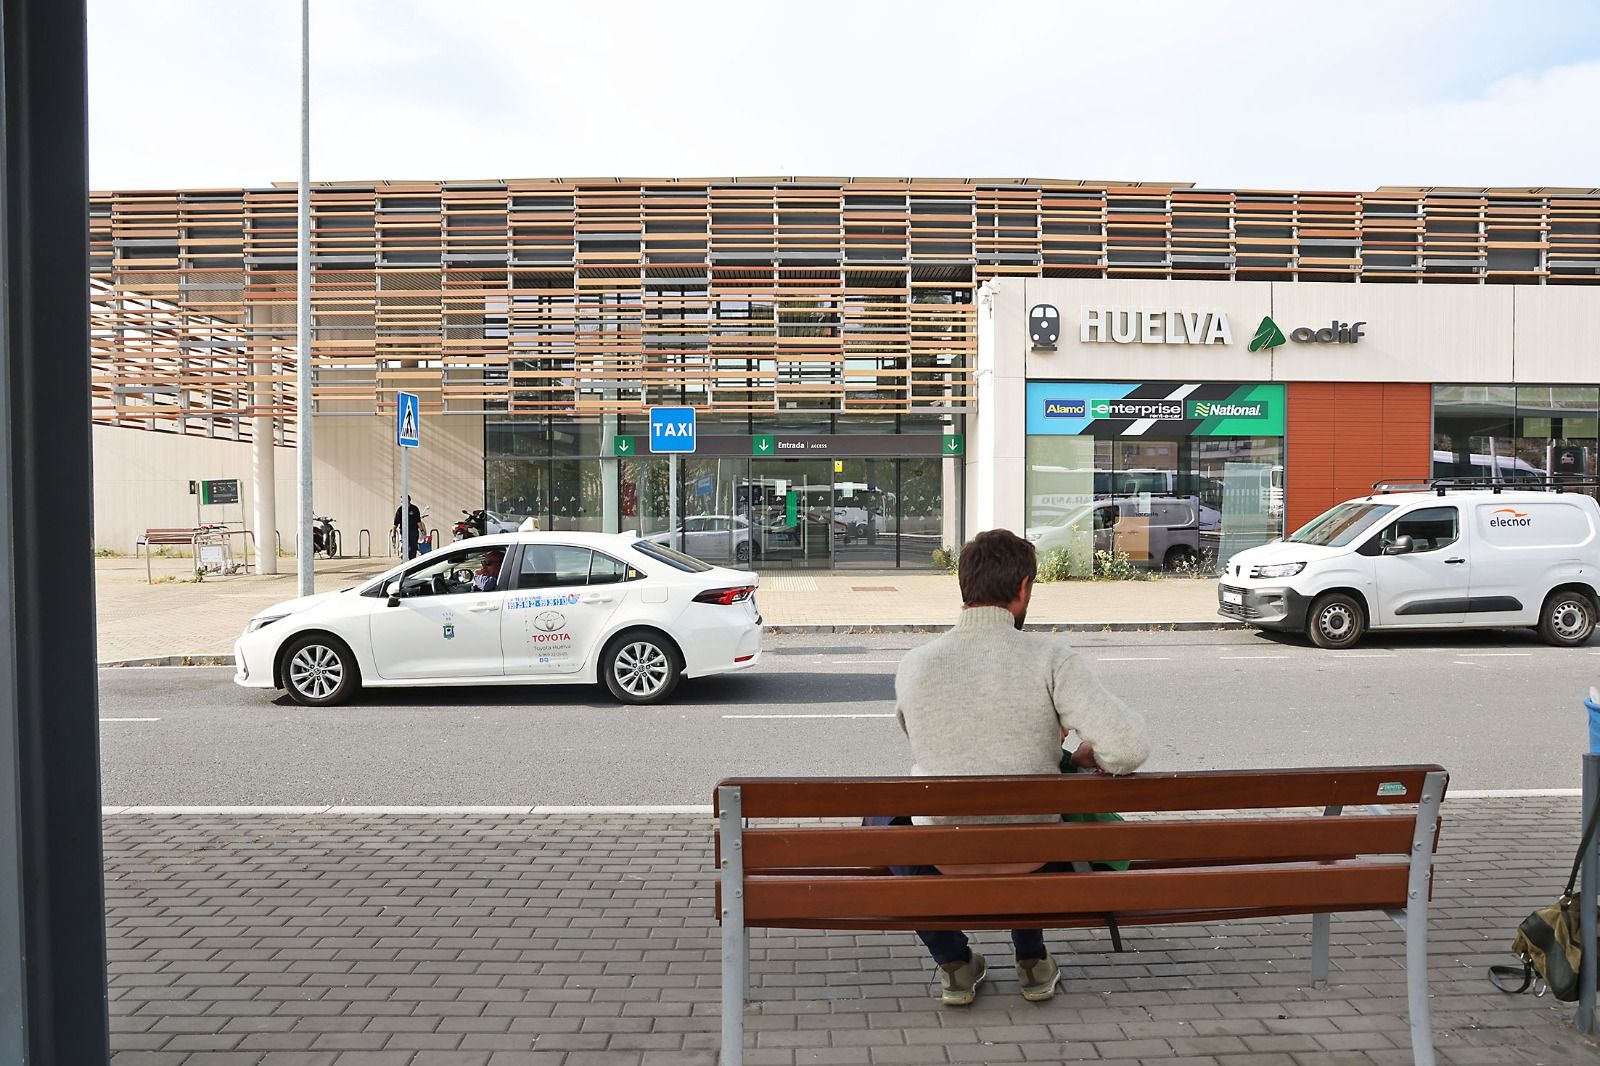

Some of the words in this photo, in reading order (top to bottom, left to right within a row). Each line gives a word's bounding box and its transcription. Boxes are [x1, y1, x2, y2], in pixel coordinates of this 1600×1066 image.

[1081, 305, 1233, 346] HUELVA
[1290, 320, 1367, 344] adif
[1047, 404, 1084, 414] Alamo
[1096, 402, 1181, 416] enterprise
[652, 422, 693, 437] TAXI
[1490, 517, 1531, 527] elecnor
[532, 633, 570, 642] TOYOTA
